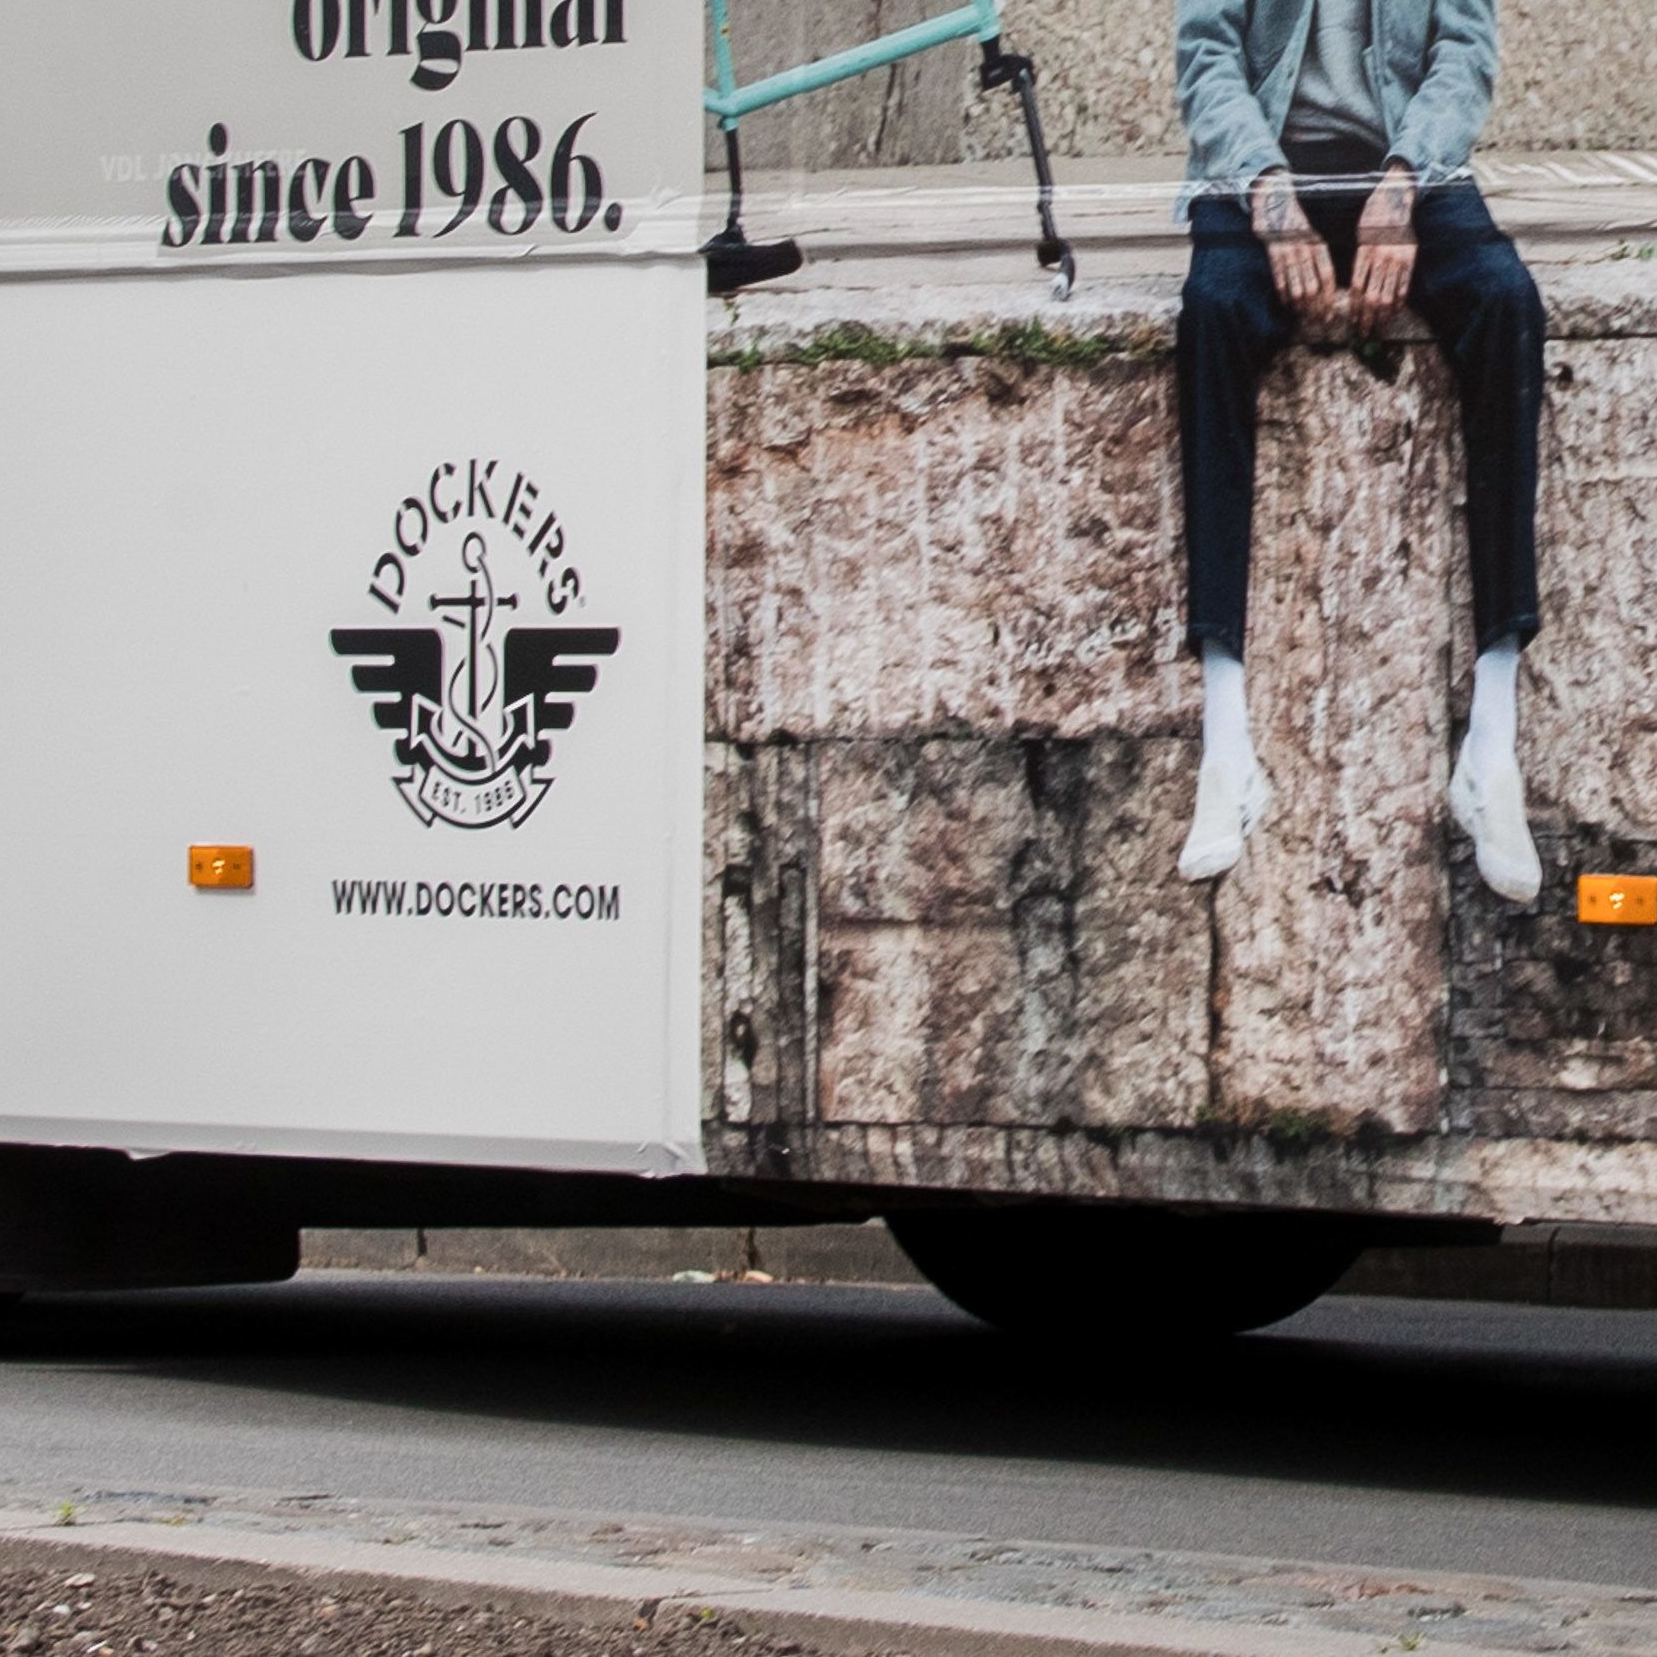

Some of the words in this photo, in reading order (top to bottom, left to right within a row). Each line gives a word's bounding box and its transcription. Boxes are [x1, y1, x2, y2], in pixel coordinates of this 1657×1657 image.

[161, 121, 375, 249] since
[392, 111, 623, 239] 1986.
[366, 457, 583, 616] DOCKERS
[331, 878, 621, 922] WWW.DOCKERS.COM
